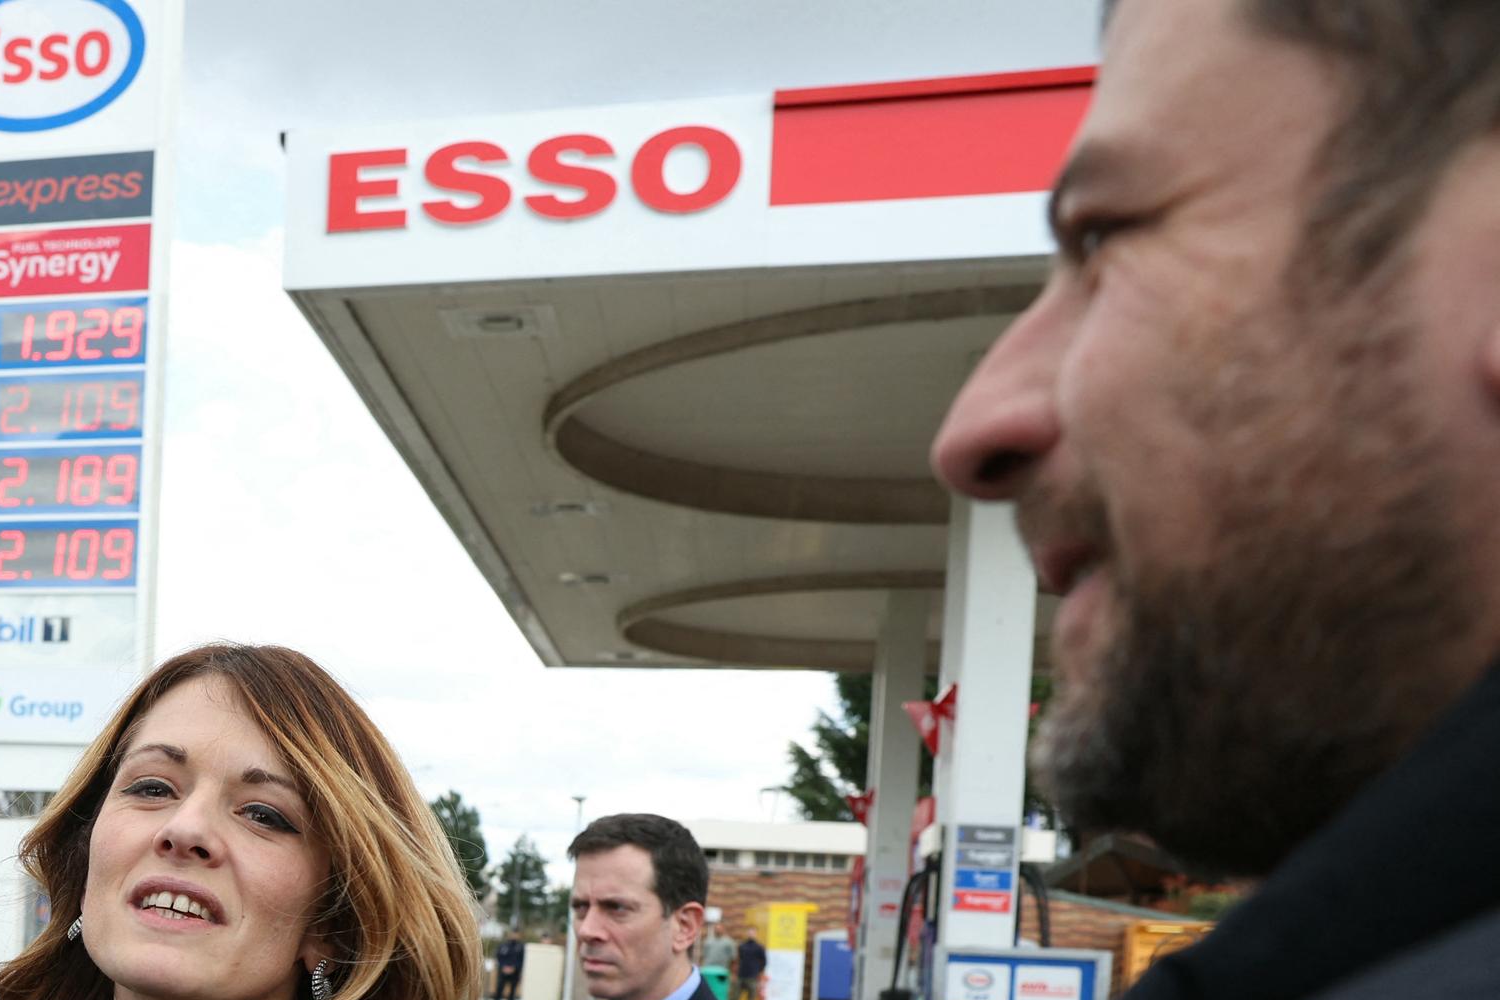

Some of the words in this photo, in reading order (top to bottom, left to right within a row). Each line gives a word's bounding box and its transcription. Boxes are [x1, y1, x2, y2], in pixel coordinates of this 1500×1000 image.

[326, 125, 743, 234] ESSO
[20, 306, 145, 361] 1.929
[9, 695, 84, 722] Group
